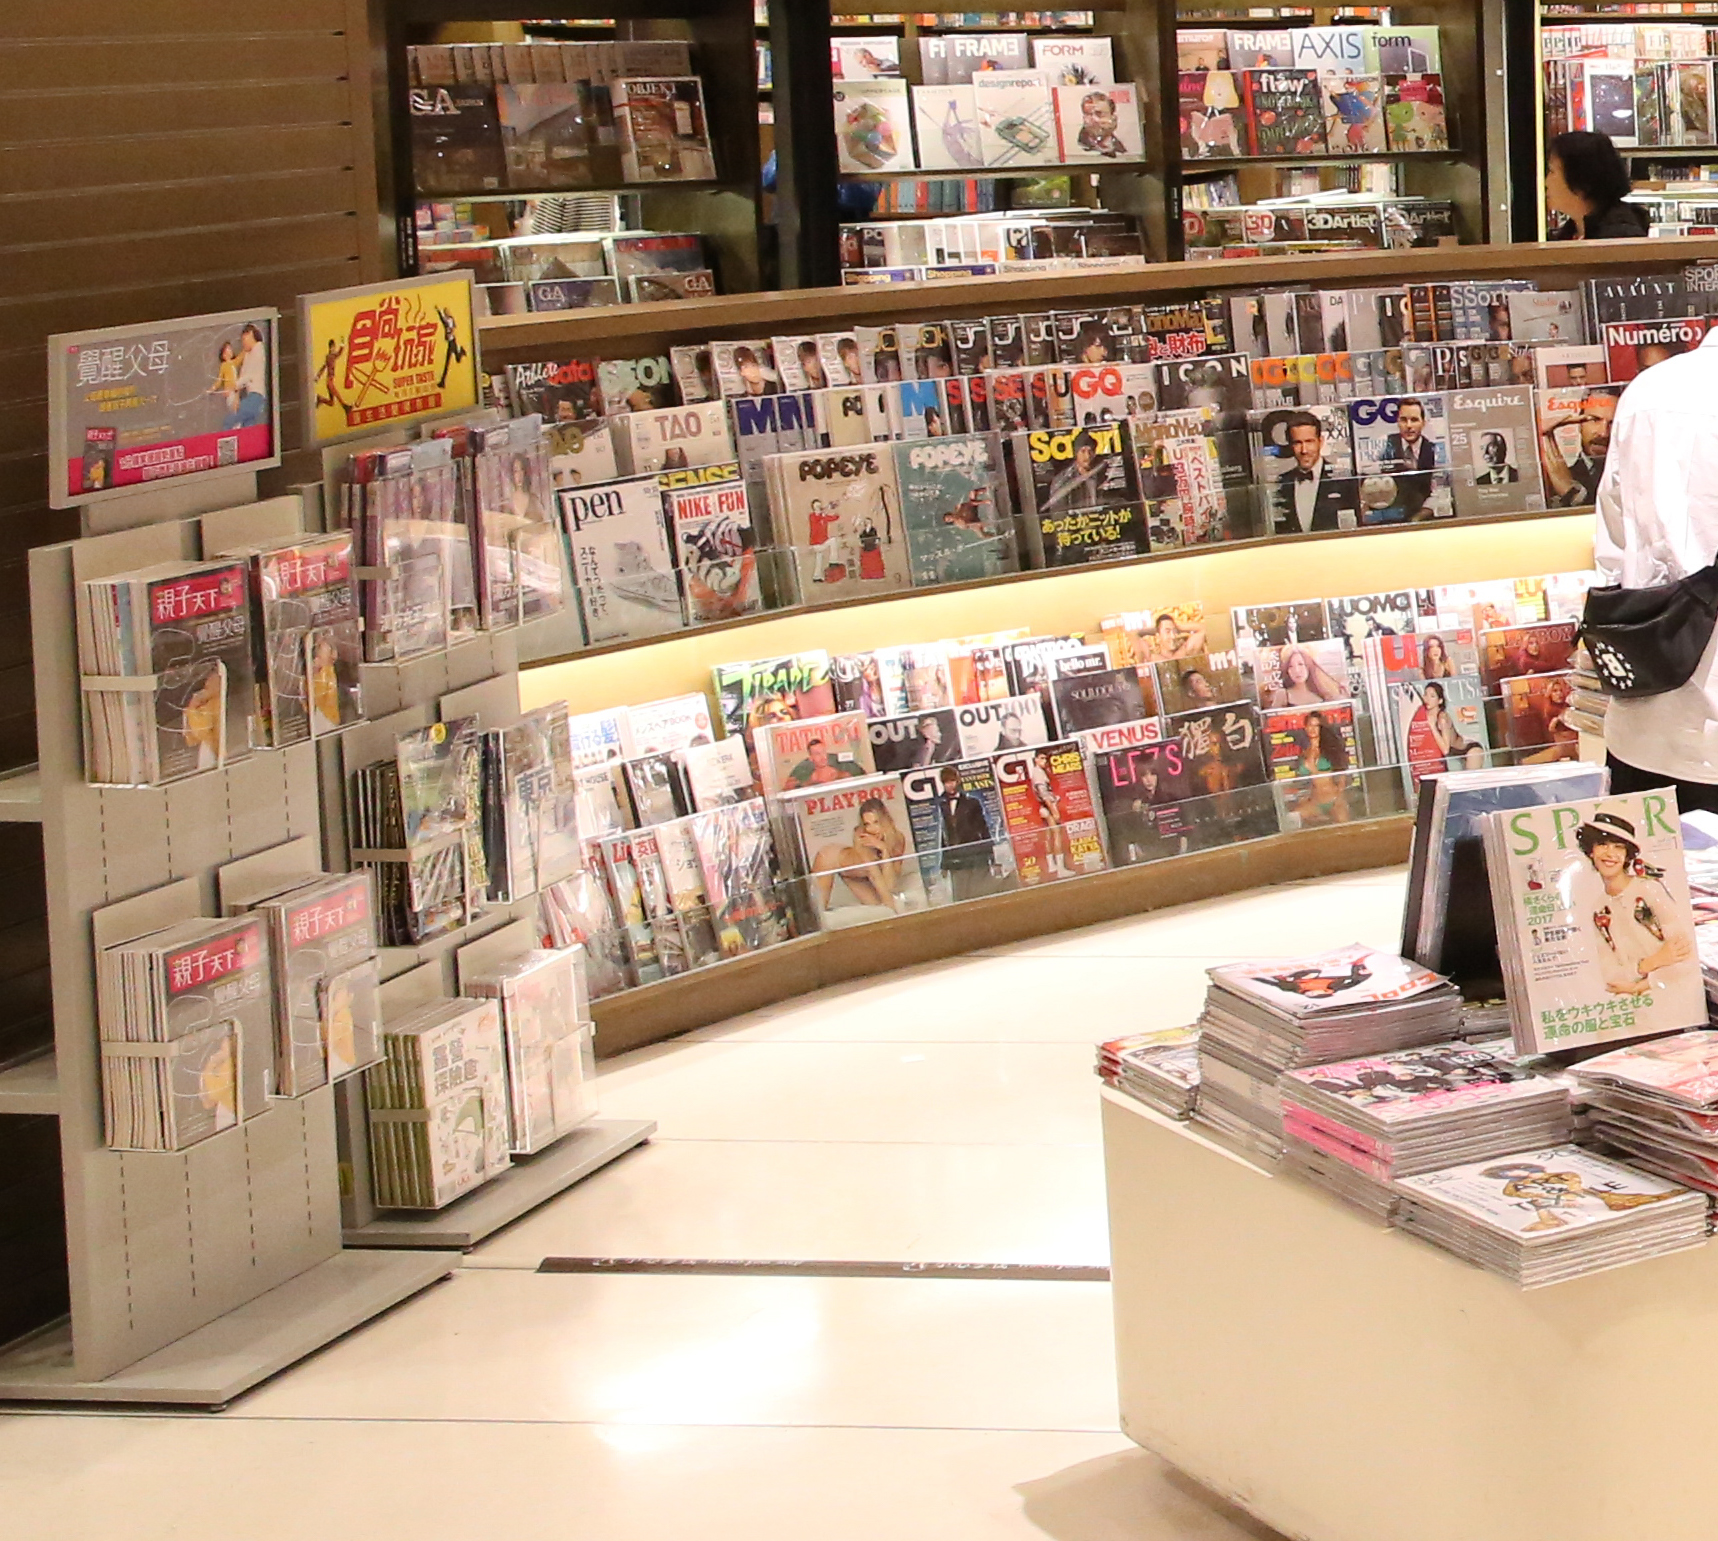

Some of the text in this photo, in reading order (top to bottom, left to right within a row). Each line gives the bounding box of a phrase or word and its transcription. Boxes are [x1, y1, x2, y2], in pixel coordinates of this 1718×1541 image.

[1041, 44, 1085, 57] FORM
[1298, 32, 1362, 60] AXIS
[1370, 32, 1412, 49] form
[1608, 321, 1692, 348] Numéro
[1071, 366, 1125, 399] GQ
[1350, 398, 1401, 427] GQ
[1453, 394, 1525, 411] Esquire
[1452, 432, 1468, 446] 25
[799, 452, 880, 482] POPEYE
[568, 488, 626, 532] pen
[677, 490, 746, 521] NIKE FUN
[156, 585, 219, 620] 親子天下
[959, 705, 1002, 728] OUT
[869, 718, 920, 747] OUT
[1091, 722, 1159, 749] VENUS
[804, 783, 897, 816] PLAYBOY
[1509, 793, 1677, 857] SPR
[292, 905, 345, 943] 親子天下
[1526, 913, 1554, 927] 2017
[173, 949, 236, 988] 親子天下
[1540, 994, 1655, 1025] 私をウキウキさせる
[1543, 1010, 1637, 1041] 運命の服と宝石
